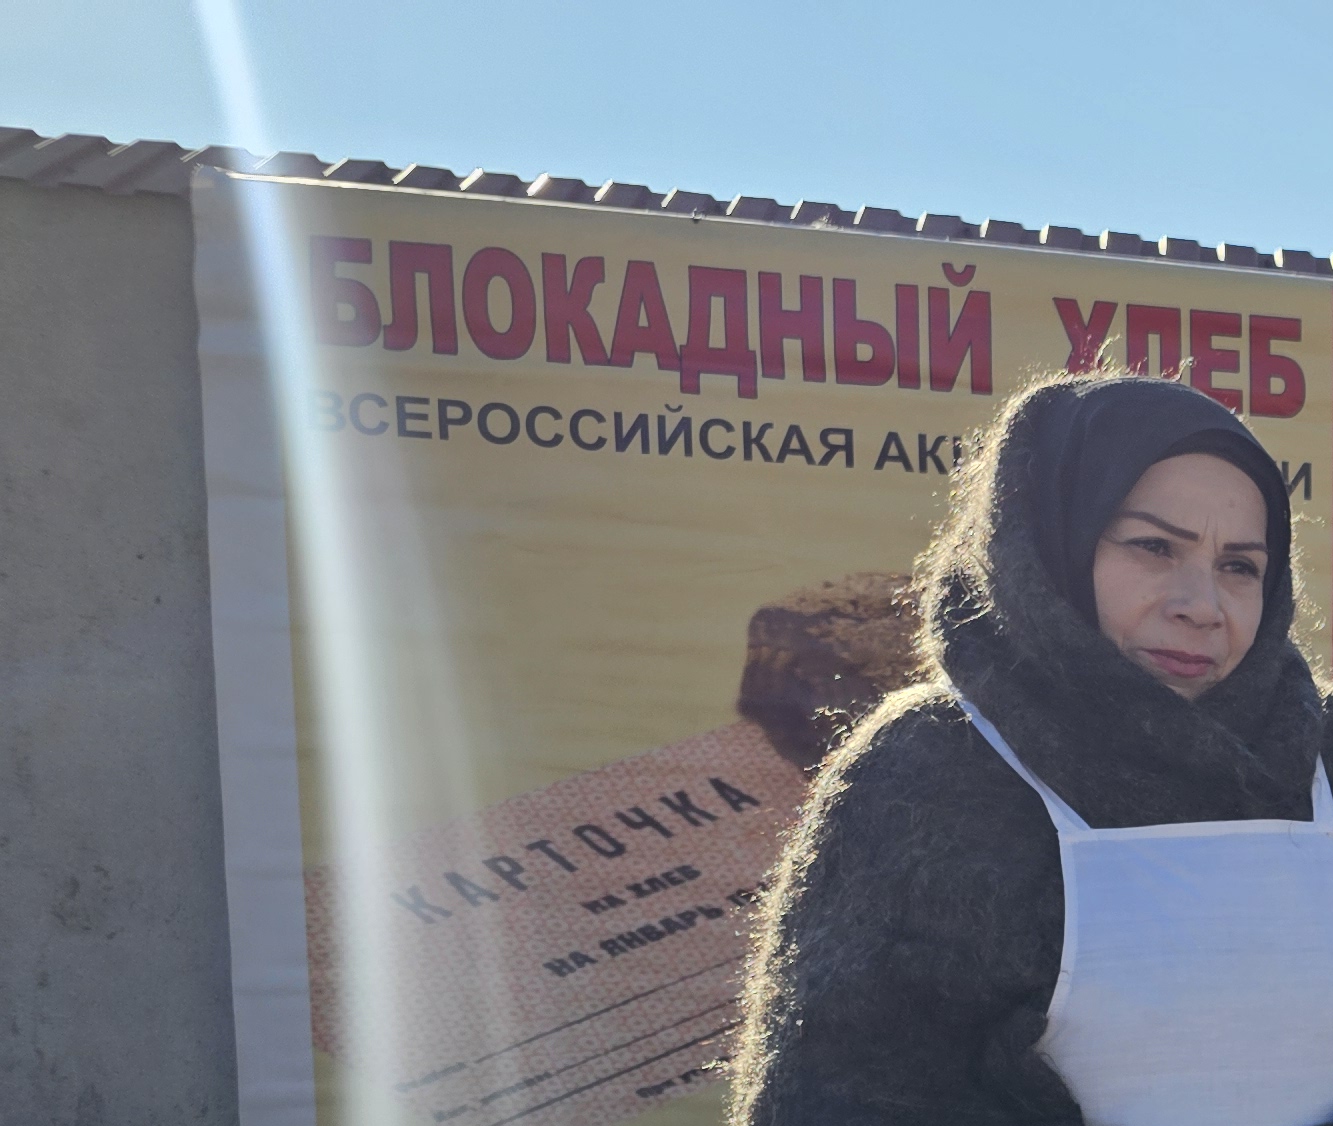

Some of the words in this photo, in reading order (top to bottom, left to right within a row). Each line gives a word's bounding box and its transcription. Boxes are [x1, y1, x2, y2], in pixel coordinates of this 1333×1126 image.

[310, 235, 993, 398] БЛОКАДНЫЙ
[306, 388, 856, 471] ВСЕРОССИЙСКАЯ
[390, 777, 759, 925] КАРТОЧКА
[543, 949, 596, 978] НА
[600, 904, 723, 958] ЯНВАРЬ
